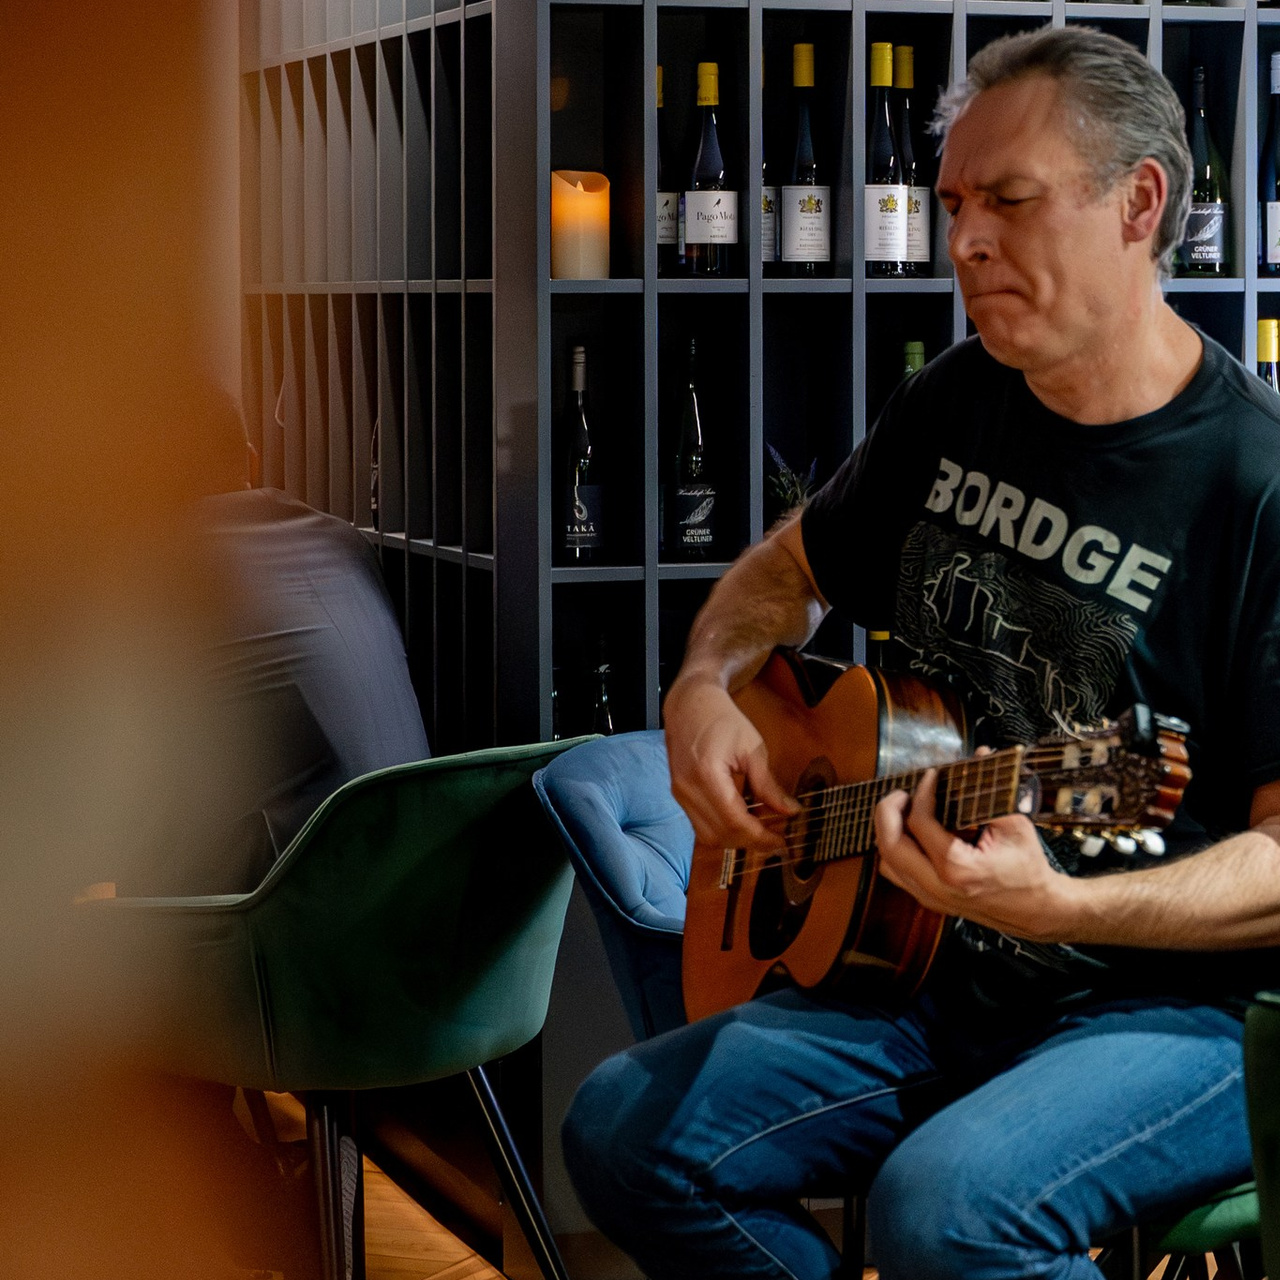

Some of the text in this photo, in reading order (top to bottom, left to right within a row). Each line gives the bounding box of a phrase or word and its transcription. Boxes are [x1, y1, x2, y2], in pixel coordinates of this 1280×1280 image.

[696, 211, 718, 223] Pago
[1194, 244, 1218, 253] GRÜNER
[686, 528, 711, 536] GRÜNER
[925, 457, 1172, 612] BORDGE
